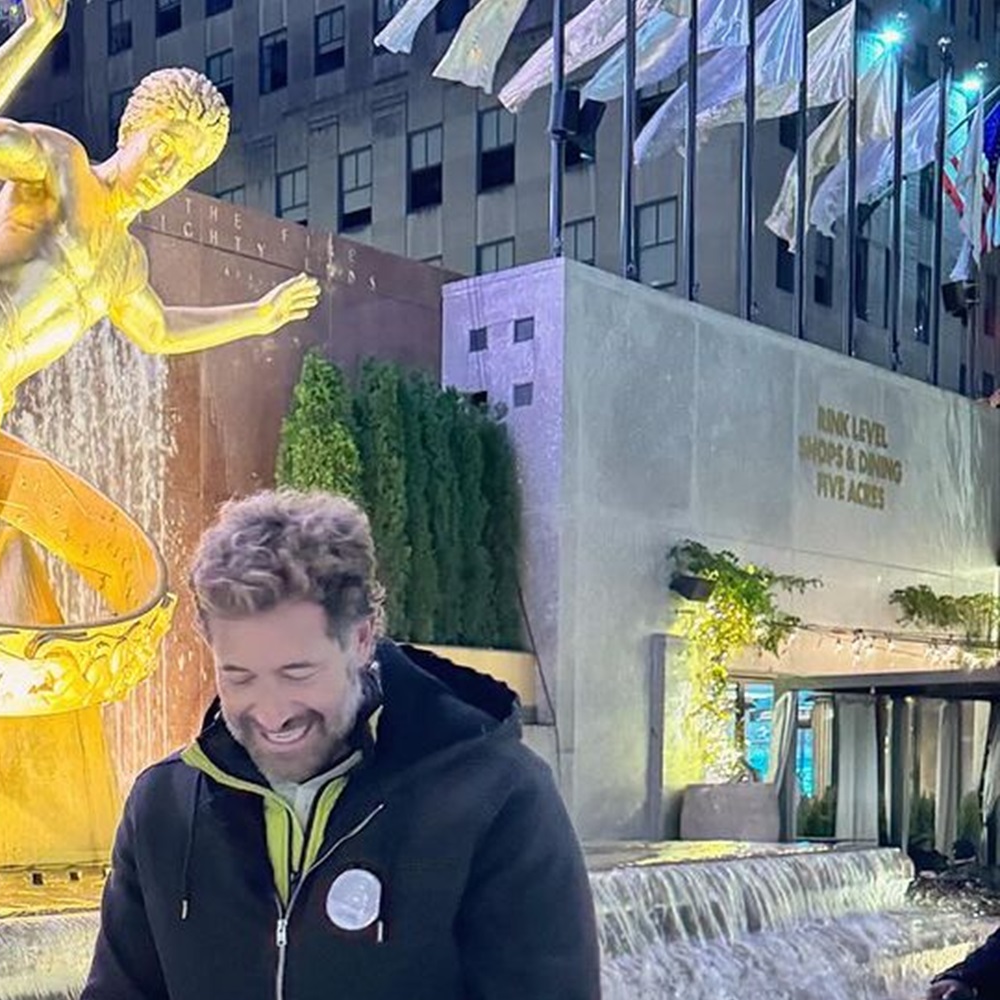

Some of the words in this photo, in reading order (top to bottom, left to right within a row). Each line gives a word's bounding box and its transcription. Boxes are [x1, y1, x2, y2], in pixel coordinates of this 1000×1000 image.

[138, 213, 266, 258] IGHTY
[185, 198, 242, 230] THE
[817, 406, 850, 438] RINK
[852, 417, 889, 449] LEVEL
[799, 435, 844, 470] SHOPS
[846, 447, 857, 472] &
[858, 451, 903, 484] DINING
[816, 471, 846, 501] FIVE
[847, 480, 885, 510] ACRES
